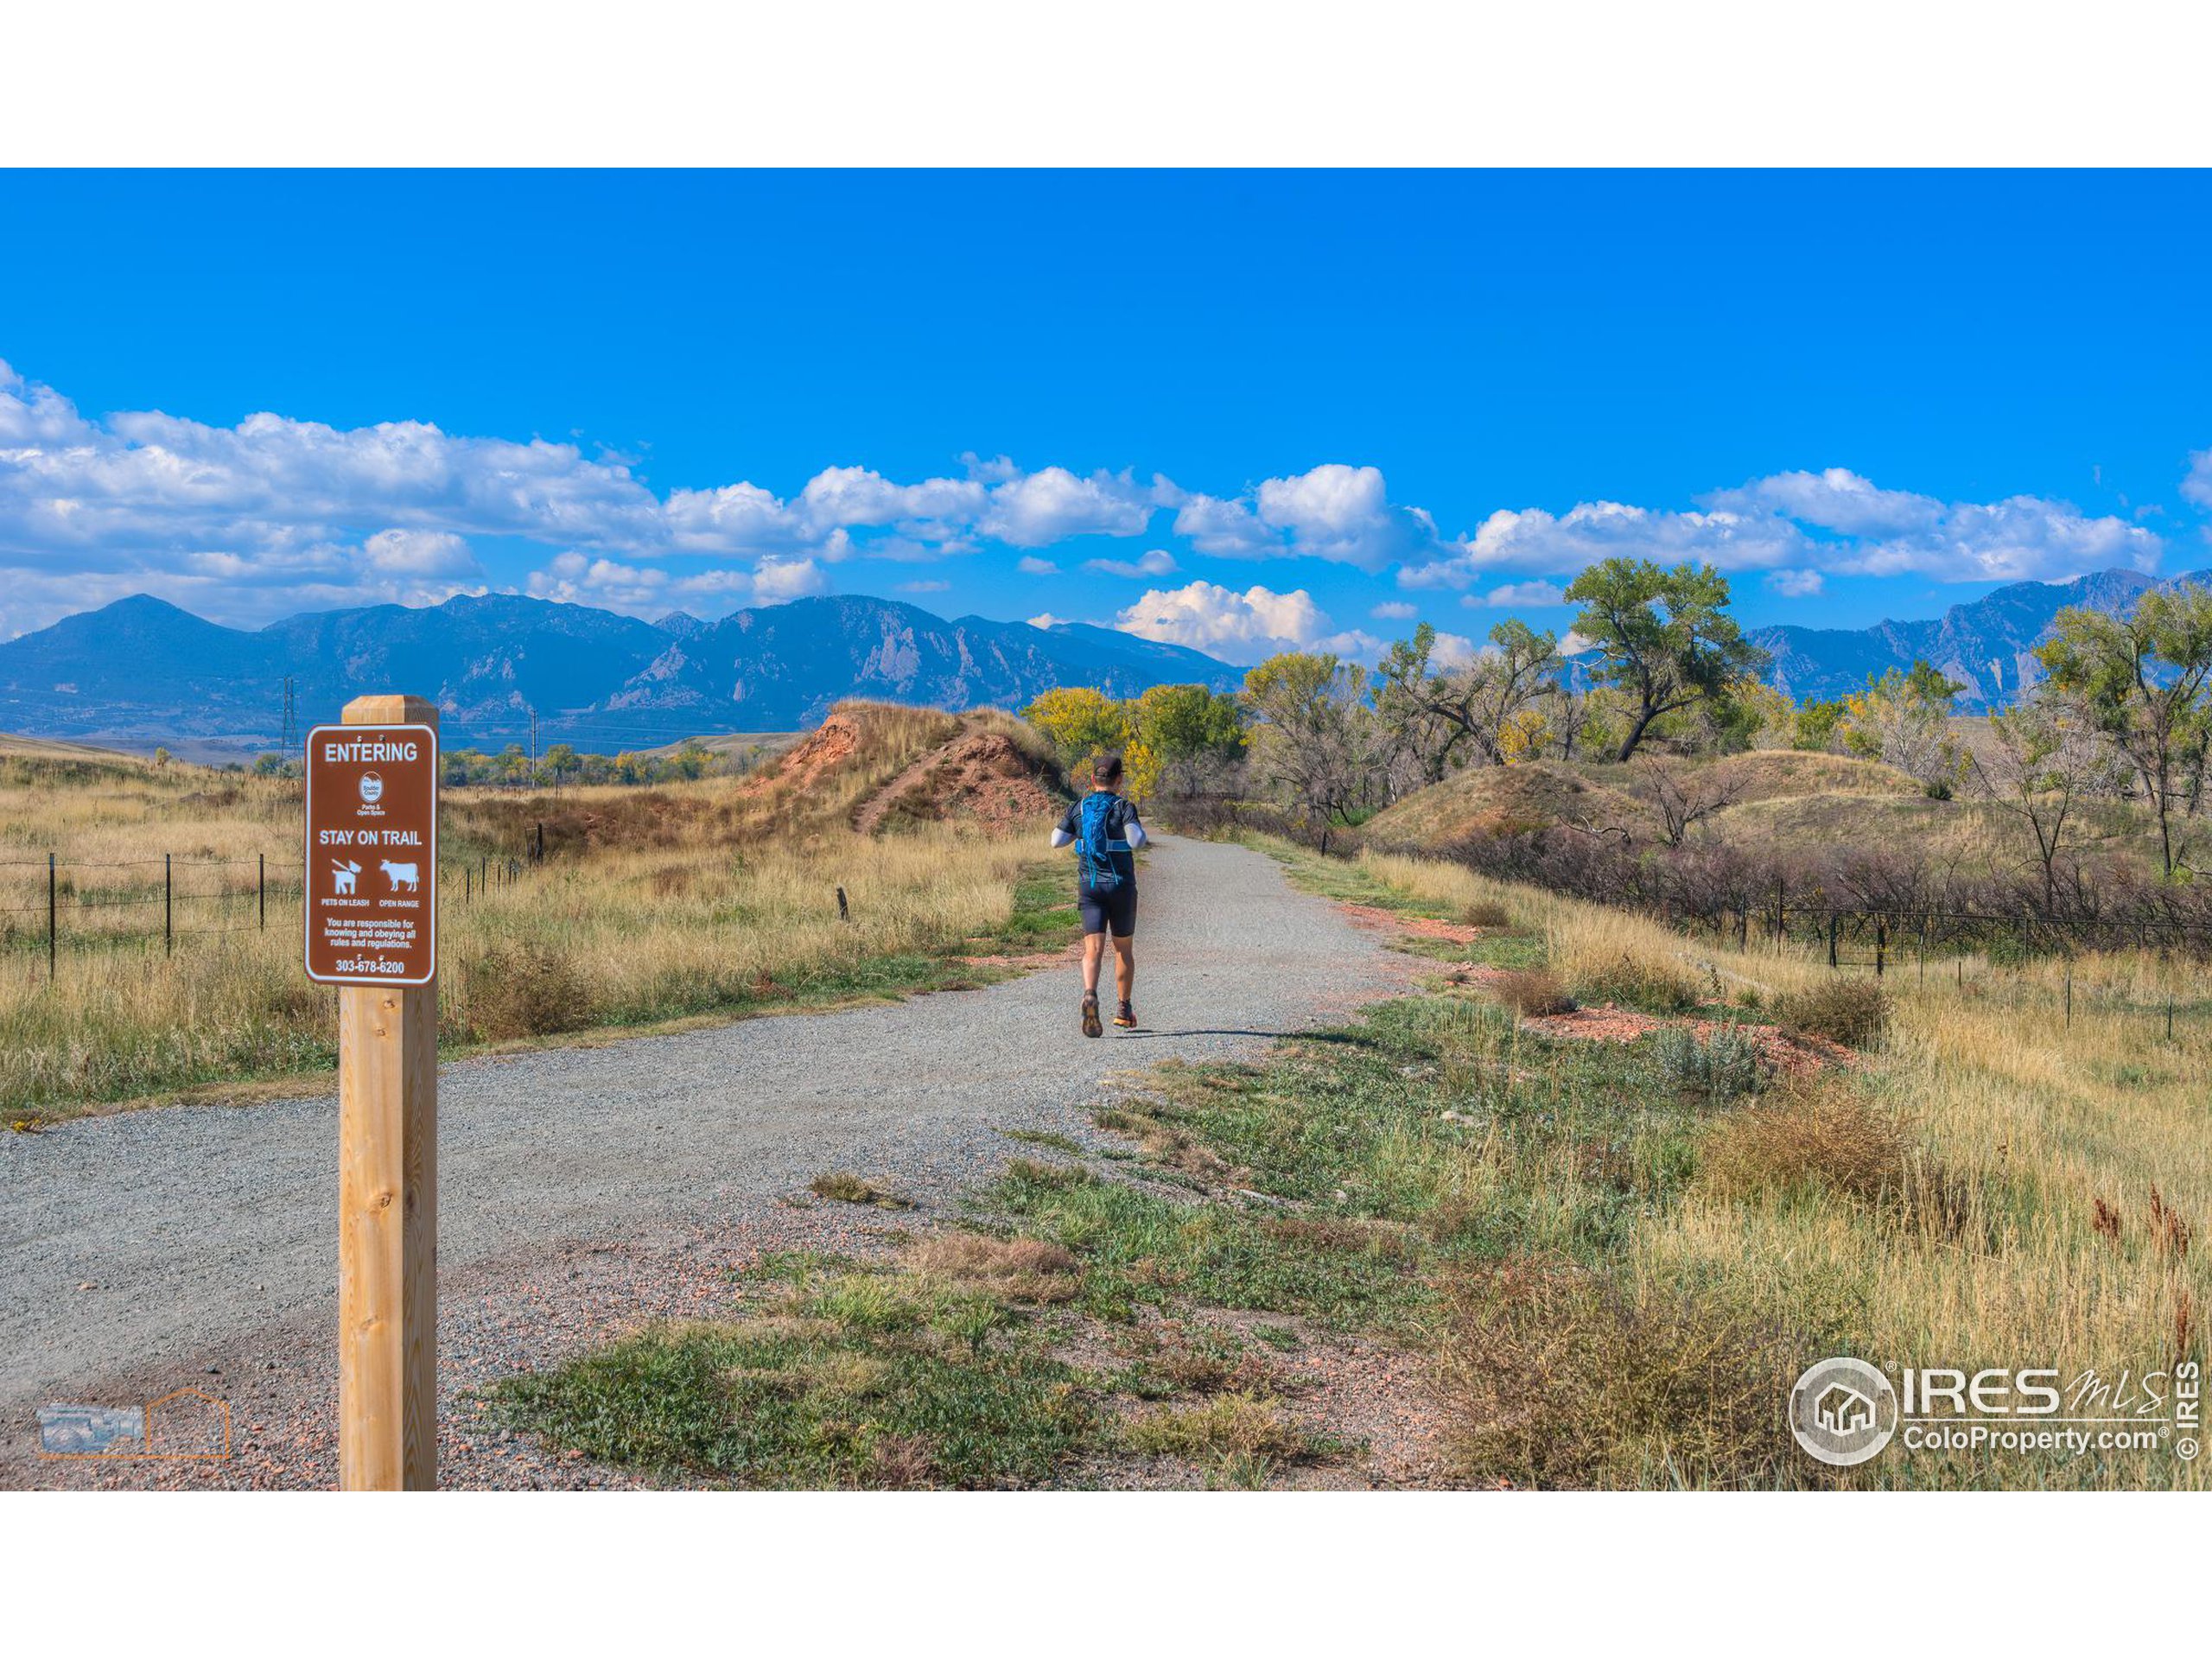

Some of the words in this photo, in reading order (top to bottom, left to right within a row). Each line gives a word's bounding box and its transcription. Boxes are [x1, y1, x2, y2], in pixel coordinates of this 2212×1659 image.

[325, 743, 417, 761] ENTERING
[320, 830, 354, 845] STAY
[358, 830, 378, 845] ON
[381, 830, 422, 845] TRAIL
[327, 918, 341, 926] You
[357, 919, 401, 930] responsible
[403, 919, 414, 929] for
[325, 927, 357, 938] knowing
[374, 930, 405, 940] obeying
[330, 938, 349, 946] rules
[351, 938, 365, 947] and
[367, 939, 412, 950] regulations.
[335, 960, 404, 973] 303-678-6200
